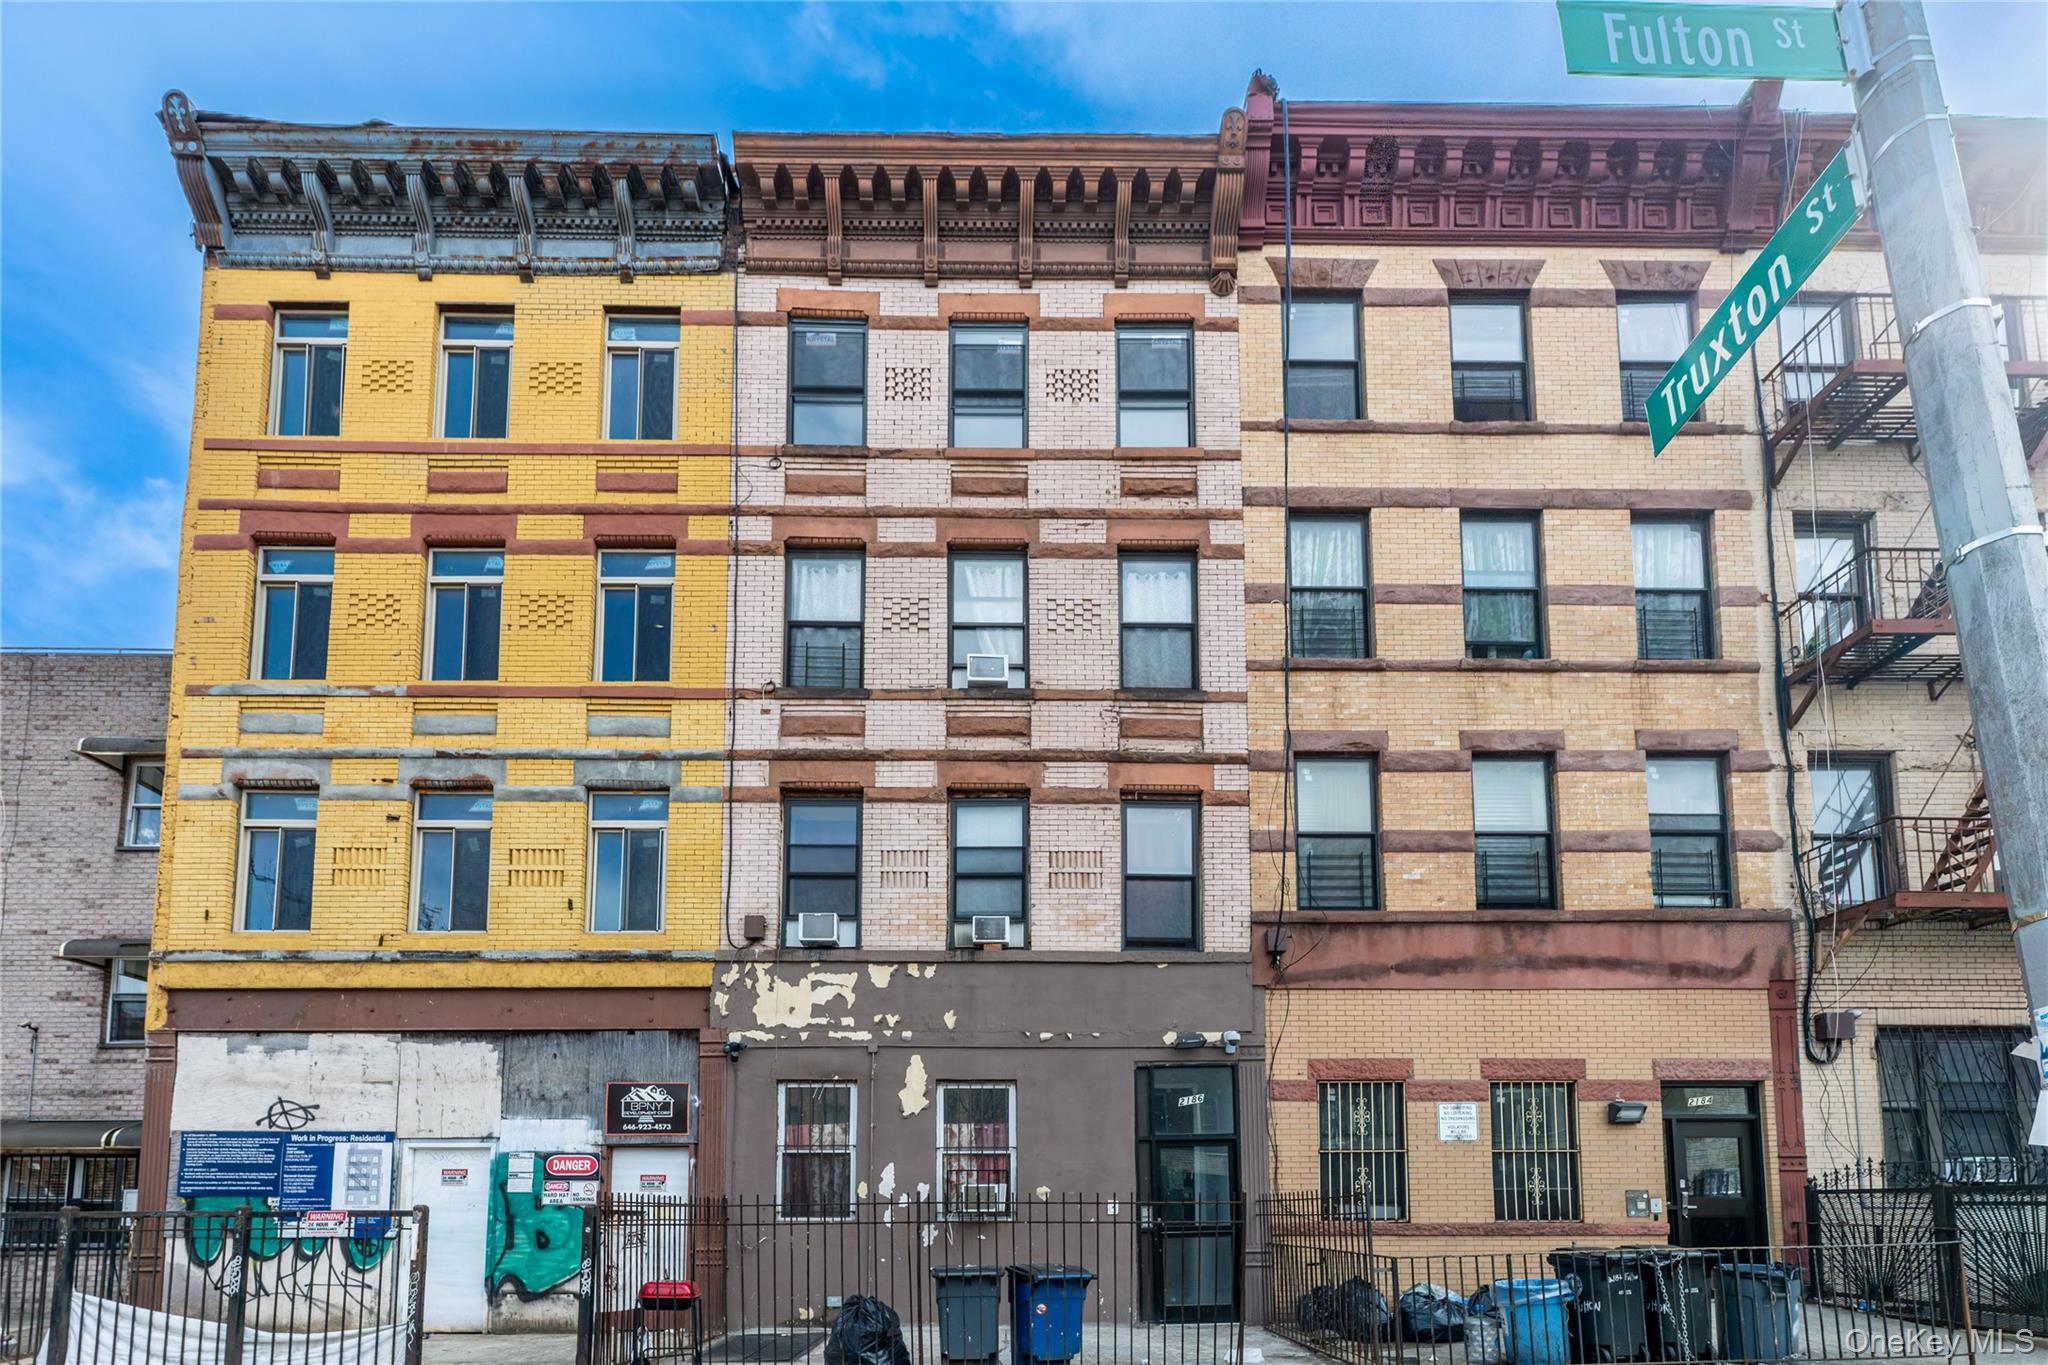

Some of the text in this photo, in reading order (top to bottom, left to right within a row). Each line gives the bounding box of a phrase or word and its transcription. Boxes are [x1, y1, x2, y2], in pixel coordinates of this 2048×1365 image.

[1603, 12, 1806, 67] Fulton St
[1660, 183, 1837, 426] Truxton St
[1180, 1094, 1203, 1105] 2186
[1689, 1097, 1712, 1105] 2184
[630, 1102, 664, 1111] BPNY
[622, 1123, 672, 1131] 646-923-4573
[291, 1134, 387, 1144] Work in Progress: Residential
[552, 1159, 591, 1171] DANGER
